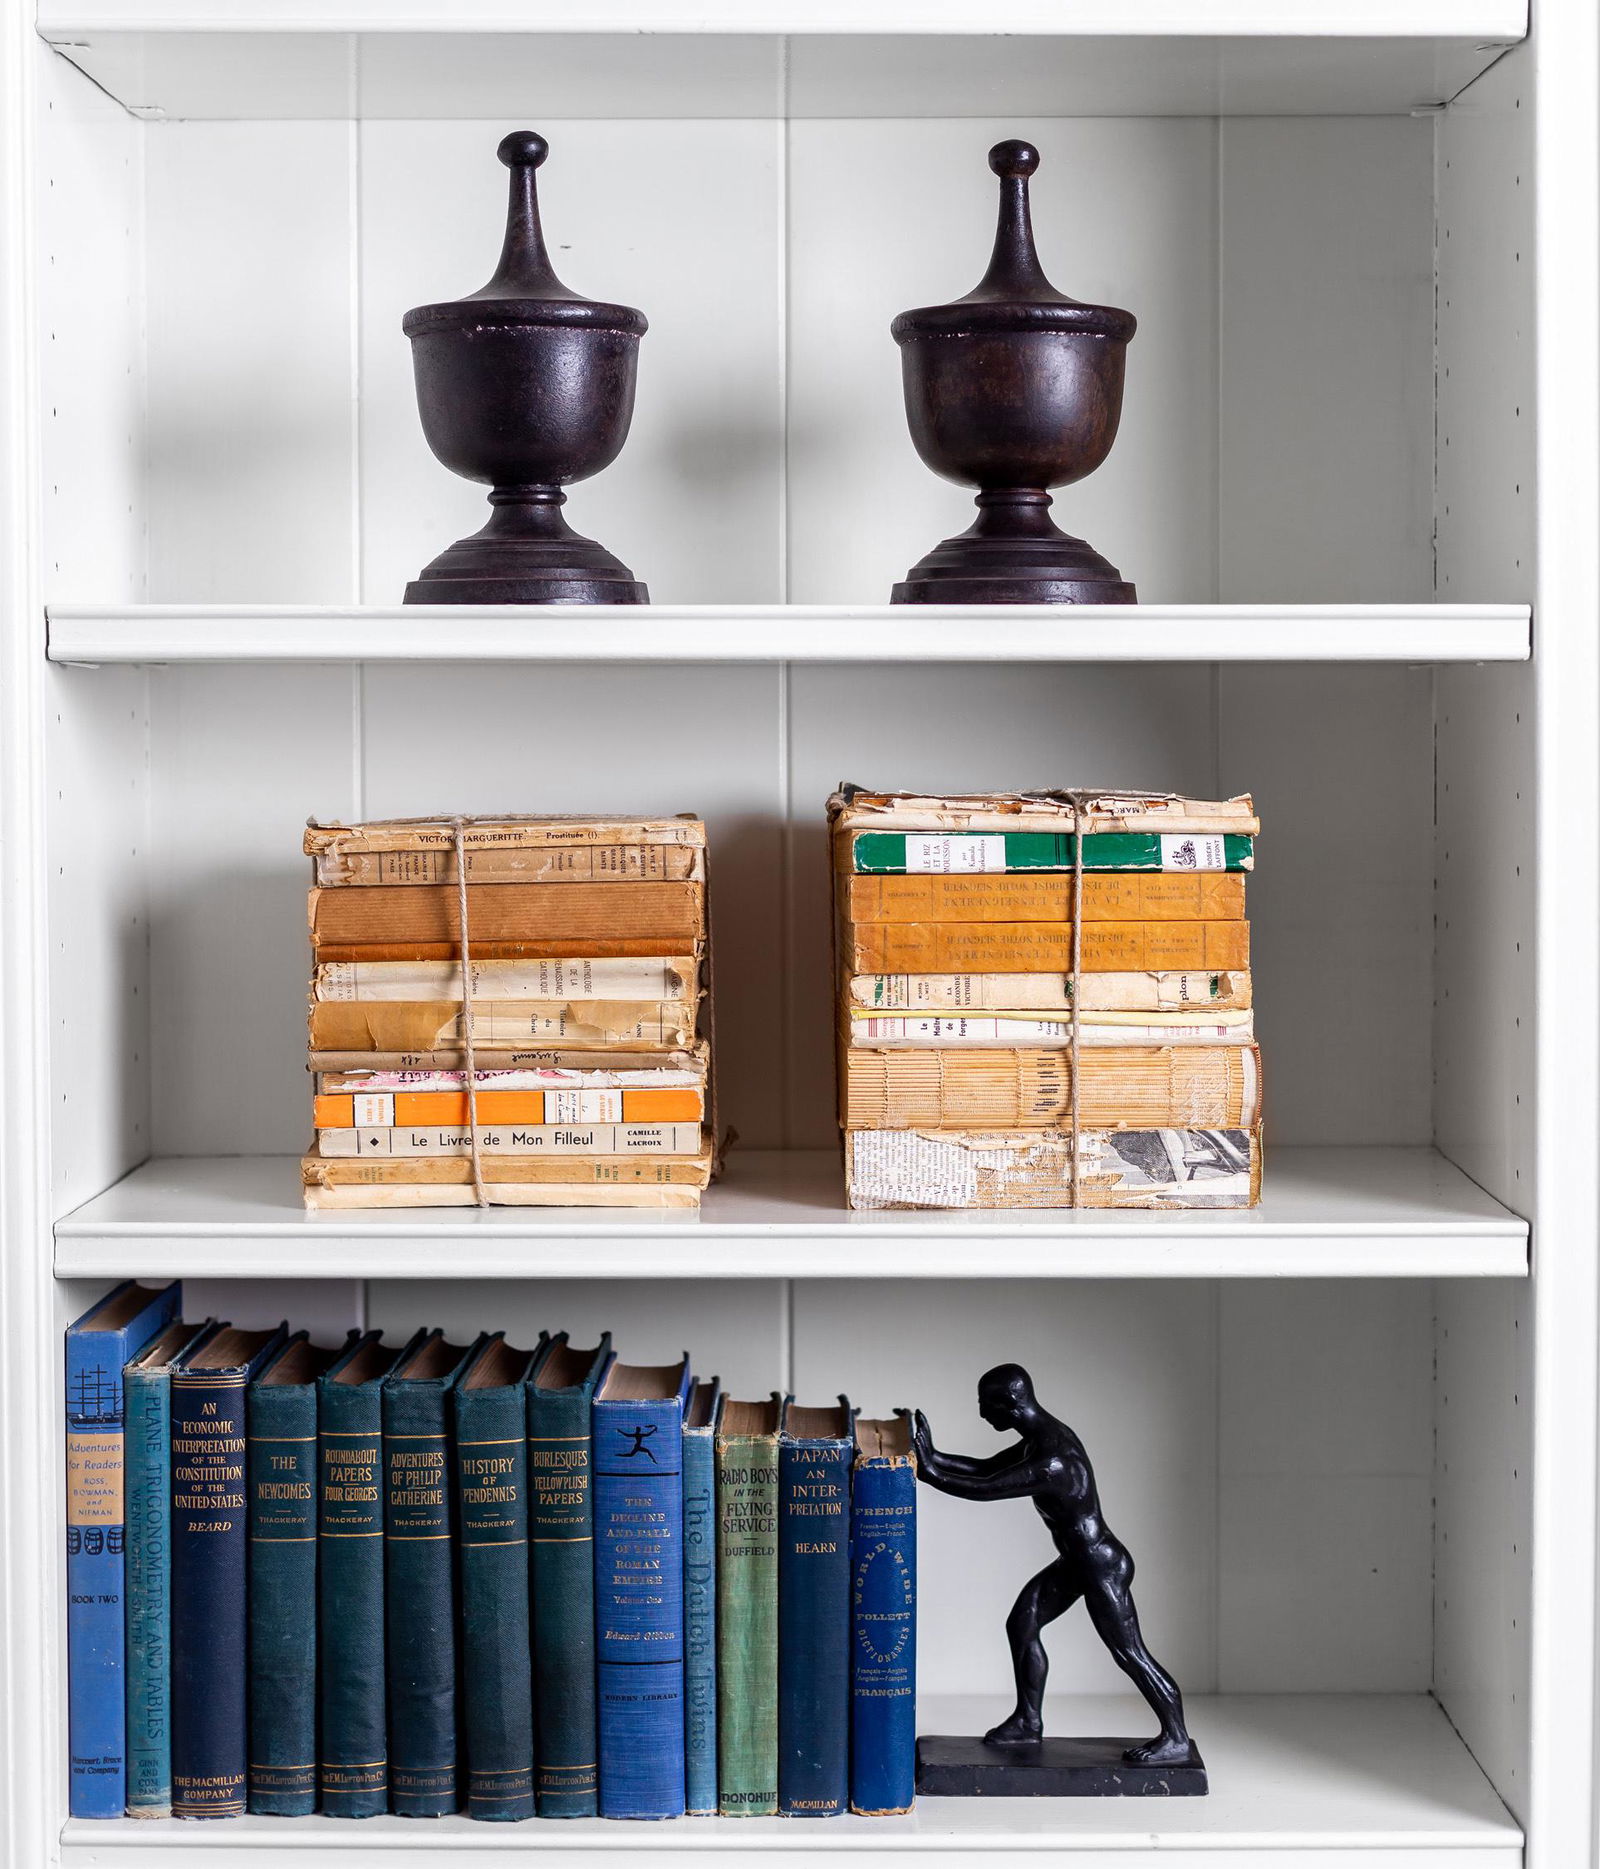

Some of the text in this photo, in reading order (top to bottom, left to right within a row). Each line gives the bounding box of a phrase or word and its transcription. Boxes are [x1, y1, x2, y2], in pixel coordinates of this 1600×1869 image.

[419, 831, 584, 843] VICTOR Prostituée
[923, 844, 931, 868] LE RIZ
[933, 845, 940, 868] ET LA
[944, 882, 992, 891] SEIGNEUR
[947, 935, 996, 945] SEIGNEUR
[998, 935, 1033, 944] NOTRE
[539, 961, 548, 995] CATHOLIQUE
[570, 969, 577, 986] DE LA
[583, 960, 592, 994] ANTHOLOGIE
[946, 987, 952, 996] LA
[1179, 975, 1190, 1001] plon
[545, 1019, 552, 1028] du
[946, 1023, 954, 1031] de
[627, 1129, 662, 1137] CAMILLE
[412, 1131, 594, 1147] Le Livre de Mon Filleul
[627, 1139, 662, 1147] LACROIX
[201, 1402, 217, 1415] AN
[182, 1421, 234, 1434] ECONOMIC
[69, 1443, 121, 1453] Adventures
[172, 1438, 246, 1453] INTERPRETATION
[207, 1456, 226, 1464] THE
[325, 1449, 377, 1464] ROUNDABOUT
[391, 1452, 444, 1468] ADVENTURES
[533, 1451, 587, 1470] BURLESQUES
[791, 1449, 840, 1463] JAPAN
[84, 1460, 122, 1470] Readers
[270, 1456, 297, 1470] THE
[464, 1458, 515, 1474] HISTORY
[175, 1466, 243, 1481] CONSTITUTION
[329, 1467, 373, 1481] PAPERS
[392, 1470, 442, 1486] OF PHILIP
[719, 1467, 778, 1485] RADIO BOYS
[806, 1470, 825, 1479] AN
[84, 1478, 108, 1486] ROSS,
[483, 1476, 497, 1486] OF
[73, 1488, 118, 1497] BOWMAN,
[191, 1484, 225, 1492] OF THE
[258, 1483, 312, 1499] NEWCOMES
[325, 1486, 378, 1501] FOUR GEORGES
[734, 1488, 765, 1497] IN THE
[793, 1484, 842, 1498] INTER-
[391, 1490, 443, 1505] CATHERINE
[463, 1486, 517, 1503] PENDENNIS
[539, 1492, 583, 1505] PAPERS
[175, 1494, 244, 1509] UNITED STATES
[625, 1498, 652, 1507] THE
[727, 1502, 773, 1517] FLYING
[789, 1502, 842, 1515] PRETATION
[855, 1506, 913, 1516] FRENCH
[259, 1516, 307, 1524] THACKERAY
[325, 1516, 373, 1524] THACKERAY
[394, 1518, 442, 1527] THACKERAY
[536, 1516, 585, 1524] THACKERAY
[611, 1513, 665, 1522] DECLINE
[188, 1521, 232, 1533] BEARD
[466, 1519, 516, 1528] THACKERAY
[723, 1518, 776, 1534] SERVICE
[607, 1528, 670, 1537] AND FALL
[615, 1545, 661, 1553] OF THE
[725, 1547, 774, 1557] DUFFIELD
[795, 1542, 836, 1553] HEARN
[145, 1396, 164, 1740] PLANE TRIGONOMETRY AND TABLES
[615, 1560, 660, 1569] ROMAN
[855, 1542, 912, 1605] WORLD WIDE
[613, 1575, 663, 1584] EMPIRE
[71, 1595, 118, 1604] BOOK TWO
[613, 1595, 663, 1604] Volume One
[687, 1488, 713, 1750] The Dutch Twins
[857, 1612, 911, 1621] FOLLETT
[605, 1630, 675, 1640] Edward Gibbon
[858, 1626, 910, 1663] DICTIONARIES
[642, 1693, 678, 1701] LIBRARY
[854, 1687, 912, 1699] FRANÇAIS
[138, 1759, 159, 1767] GINN
[87, 1765, 120, 1776] Company
[140, 1768, 158, 1776] AND
[174, 1776, 190, 1787] THE
[192, 1774, 245, 1787] MACMILLAN
[183, 1788, 234, 1799] COMPANY
[721, 1791, 777, 1804] DONOHUE
[791, 1798, 838, 1810] MACMILLAN
